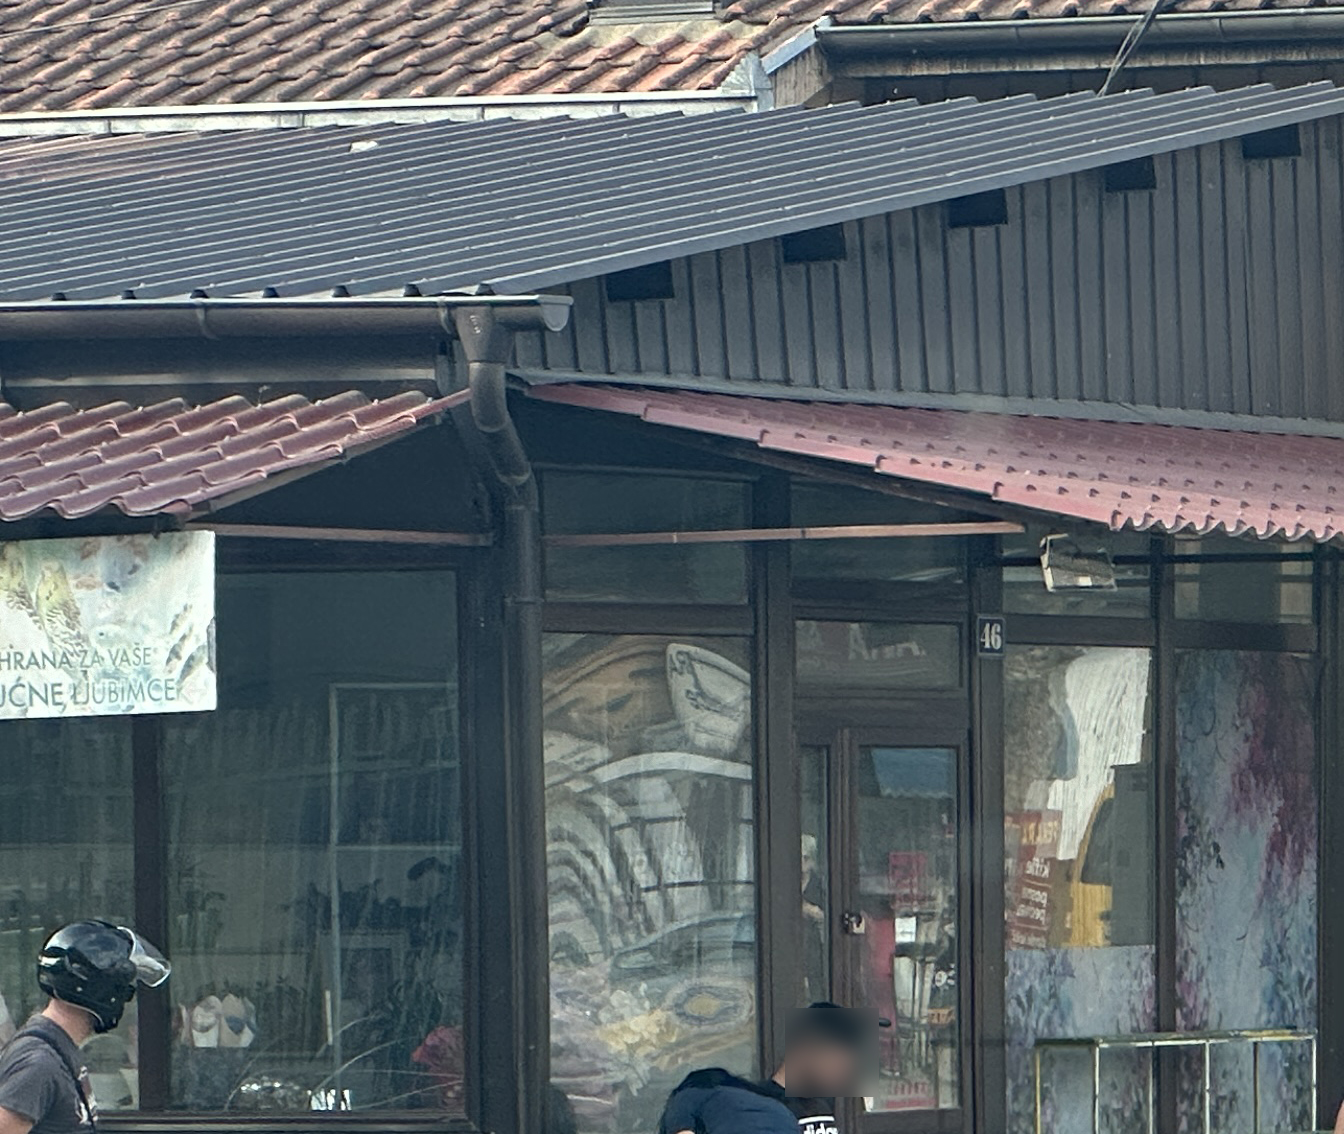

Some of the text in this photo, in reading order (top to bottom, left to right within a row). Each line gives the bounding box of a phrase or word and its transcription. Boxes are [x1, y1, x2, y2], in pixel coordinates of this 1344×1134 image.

[980, 622, 1002, 650] 46
[0, 642, 152, 672] HRANA ZA VAŠE
[73, 678, 176, 705] LJUBIMCE
